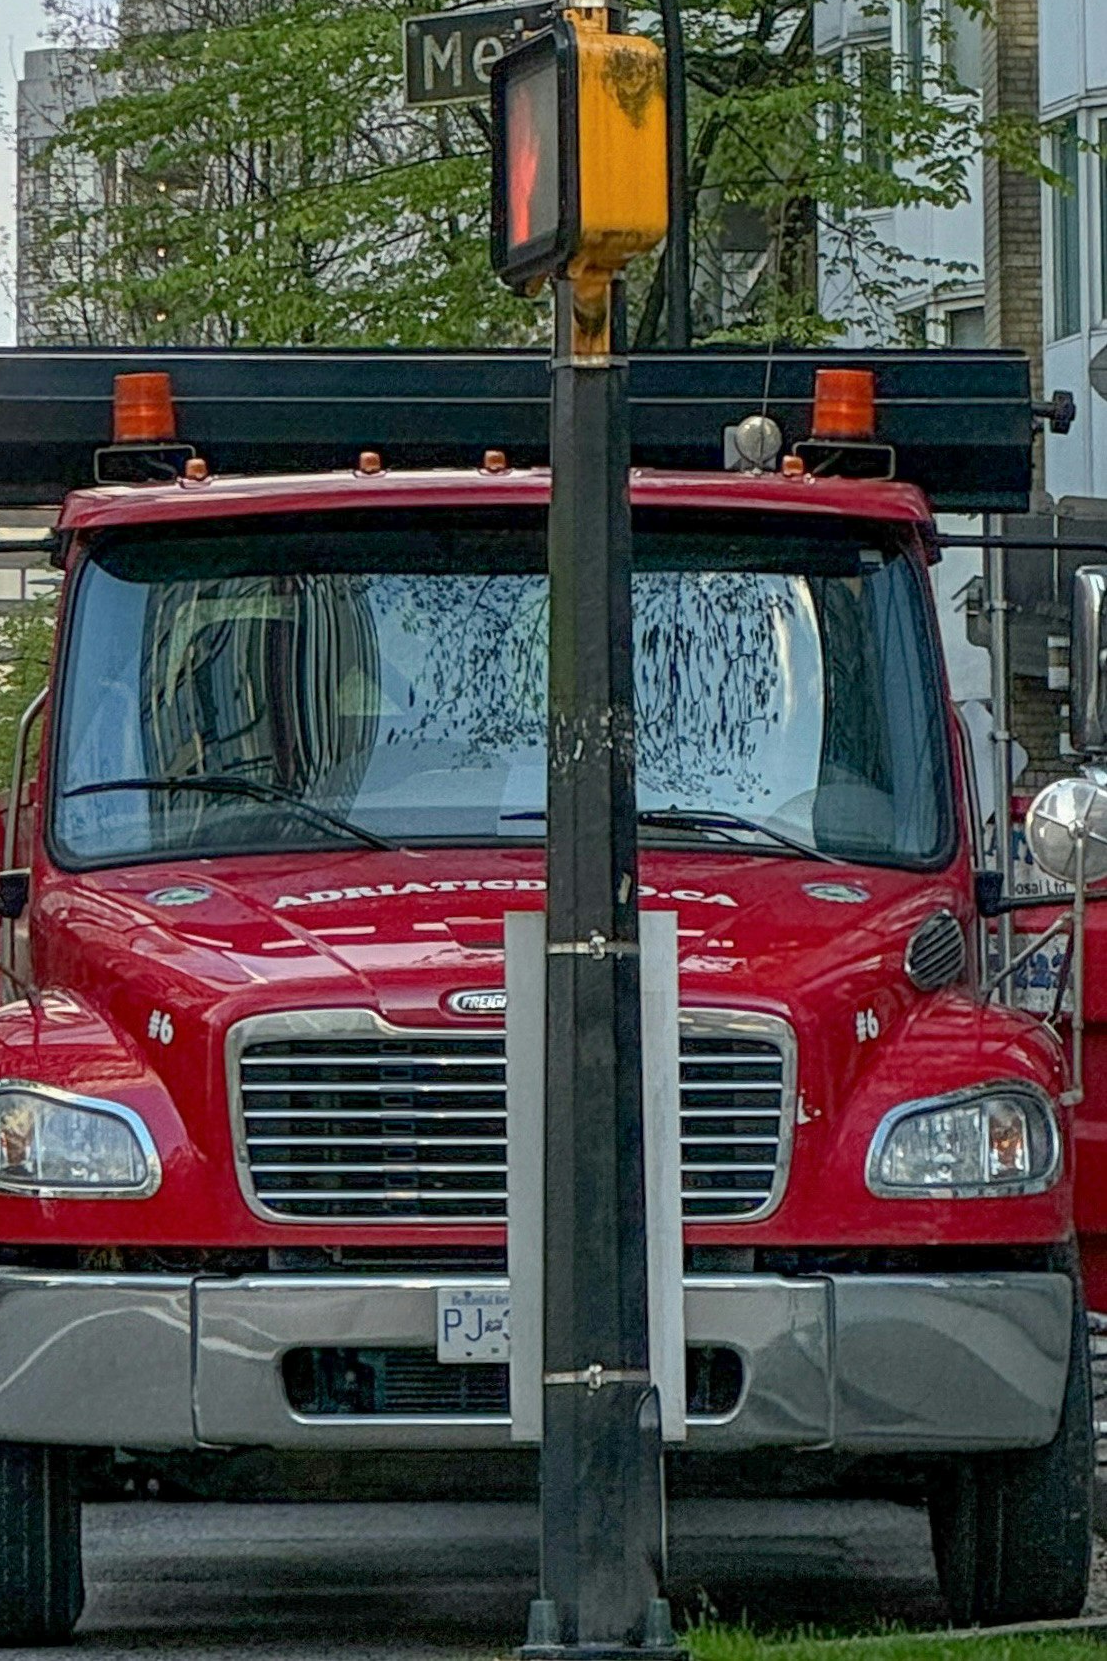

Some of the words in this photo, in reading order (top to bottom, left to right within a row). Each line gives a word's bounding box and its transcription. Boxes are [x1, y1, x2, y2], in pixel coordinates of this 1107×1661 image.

[423, 18, 523, 90] Me
[1013, 880, 1043, 895] osal
[461, 994, 507, 1010] FREIG
[148, 1008, 174, 1045] #6
[856, 1007, 879, 1043] #6
